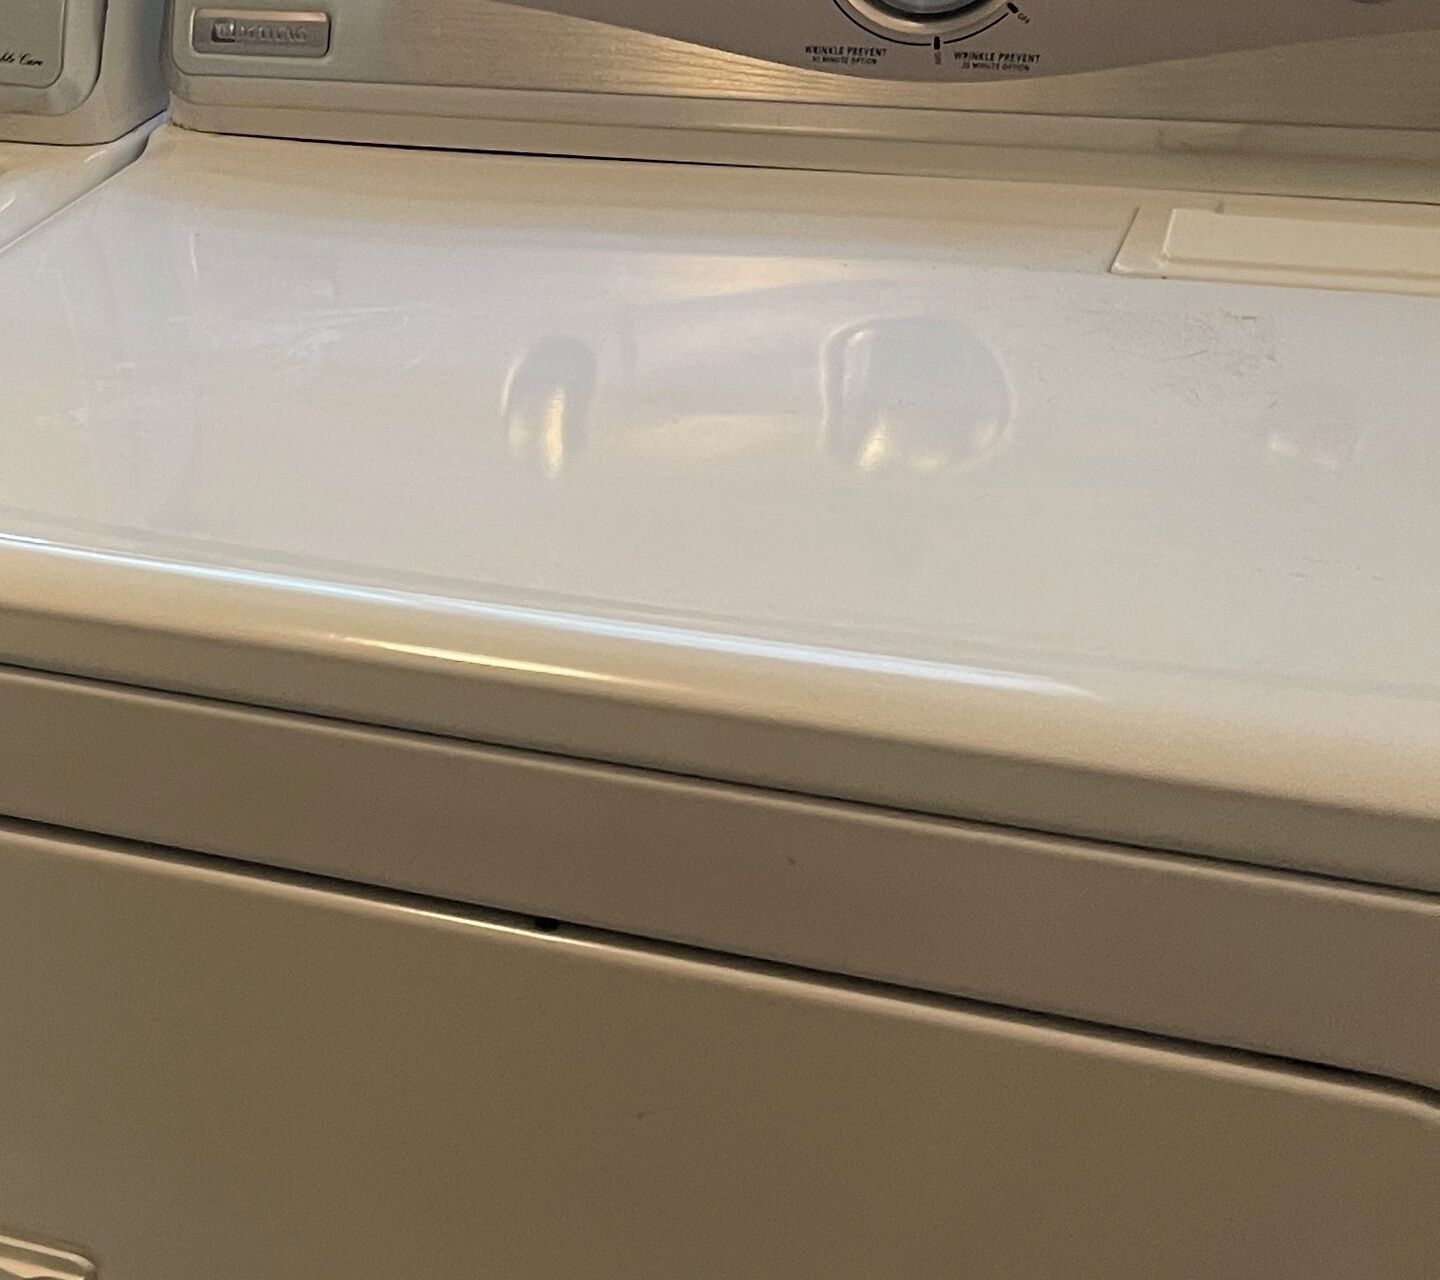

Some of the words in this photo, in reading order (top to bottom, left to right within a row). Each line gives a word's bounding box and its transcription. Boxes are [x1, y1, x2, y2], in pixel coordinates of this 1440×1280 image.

[805, 46, 845, 56] WRINKLE
[847, 47, 887, 57] PREVENT
[954, 51, 995, 61] WRINKLE
[997, 52, 1040, 63] PREVENT
